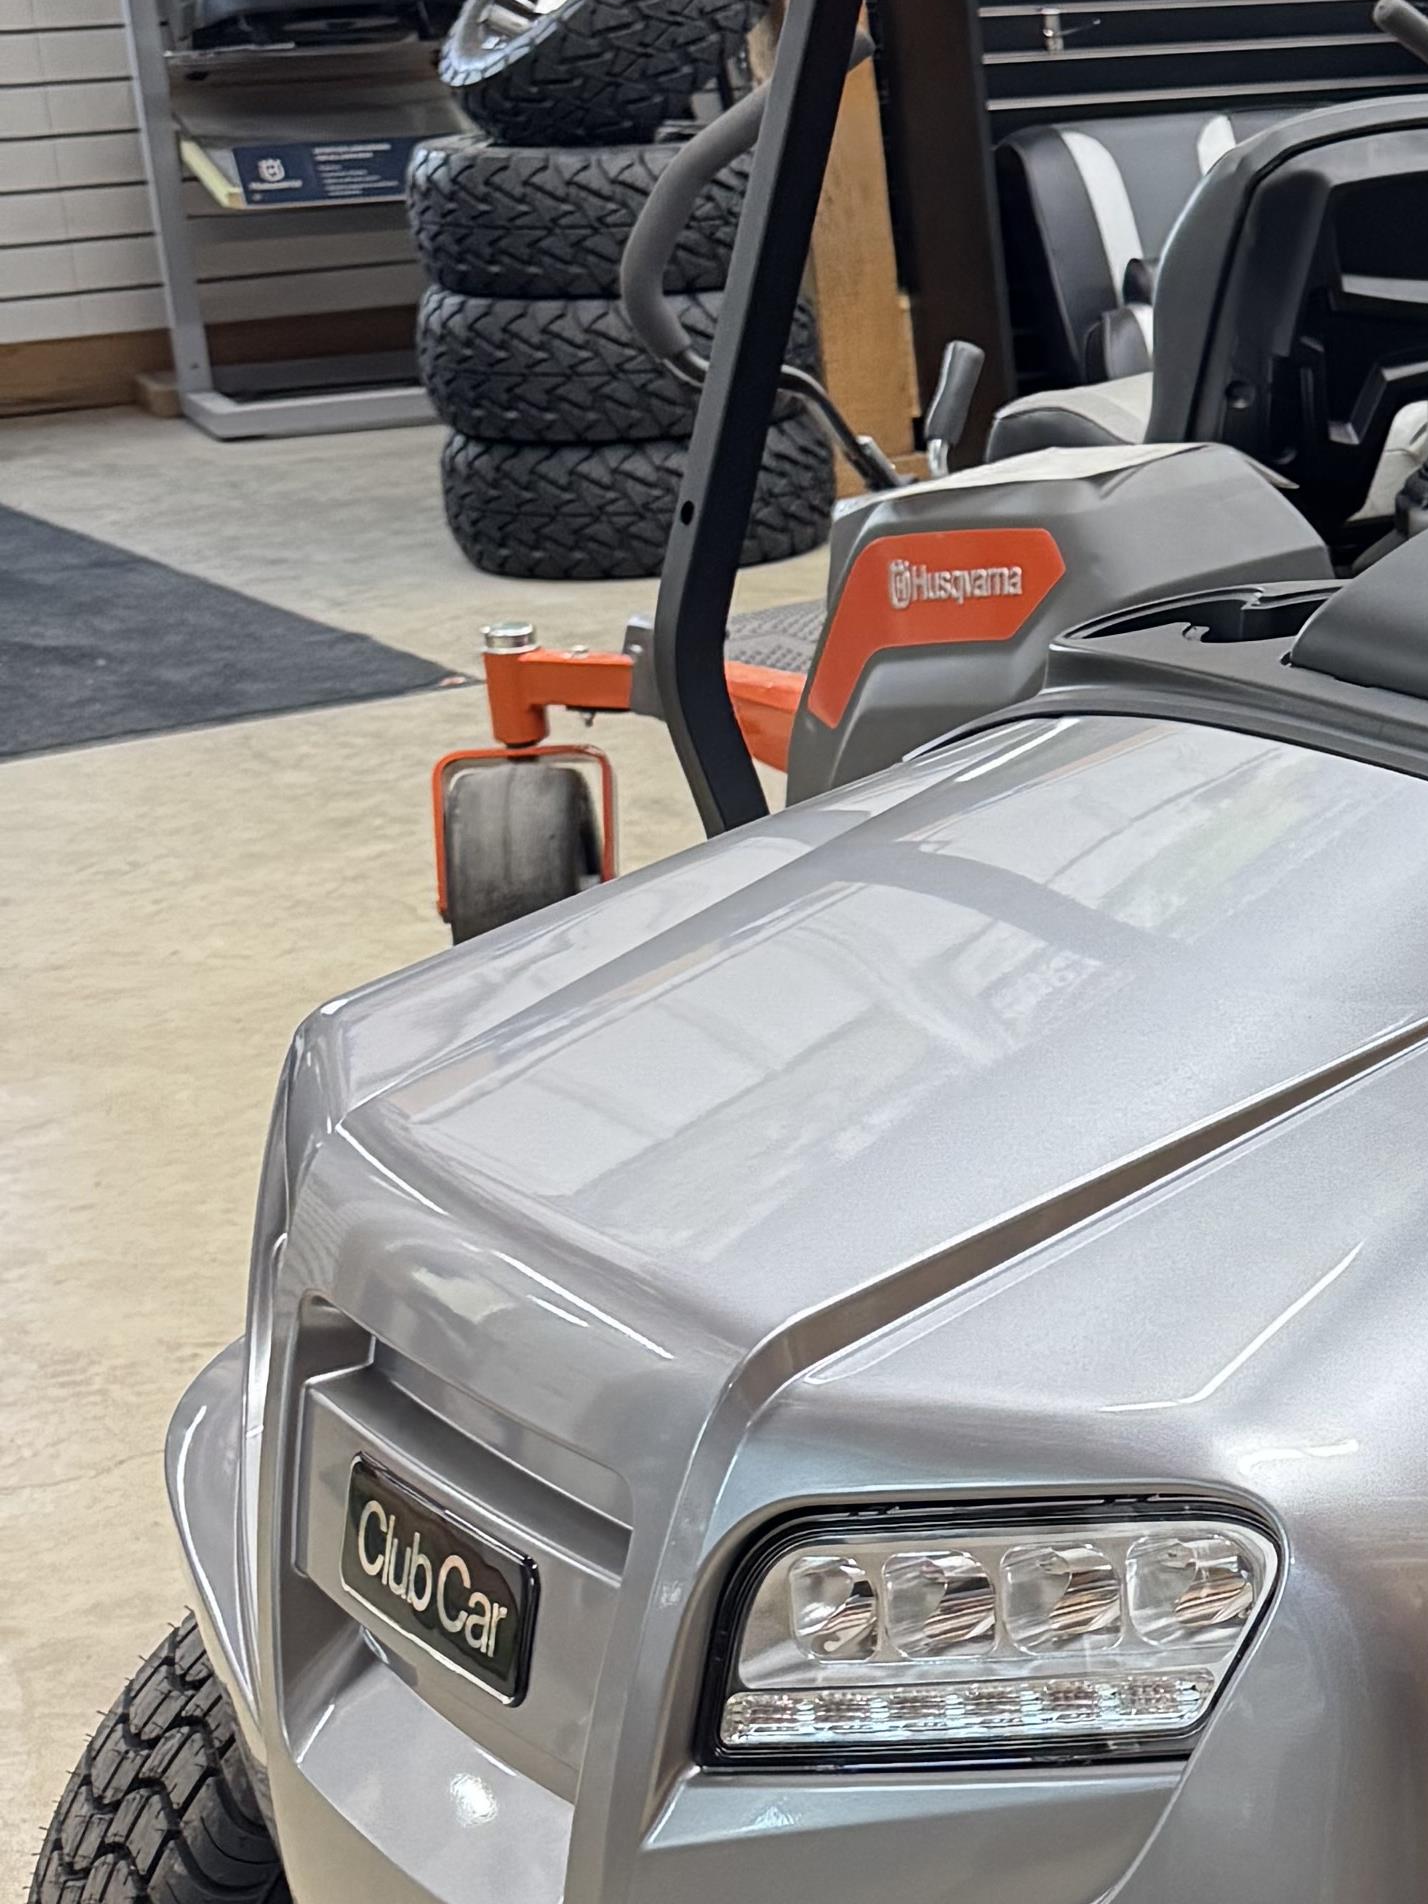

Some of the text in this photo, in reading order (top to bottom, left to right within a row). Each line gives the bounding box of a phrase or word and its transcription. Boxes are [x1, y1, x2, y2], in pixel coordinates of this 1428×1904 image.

[911, 563, 1024, 606] Husqvarna
[357, 1499, 509, 1658] Club Car
